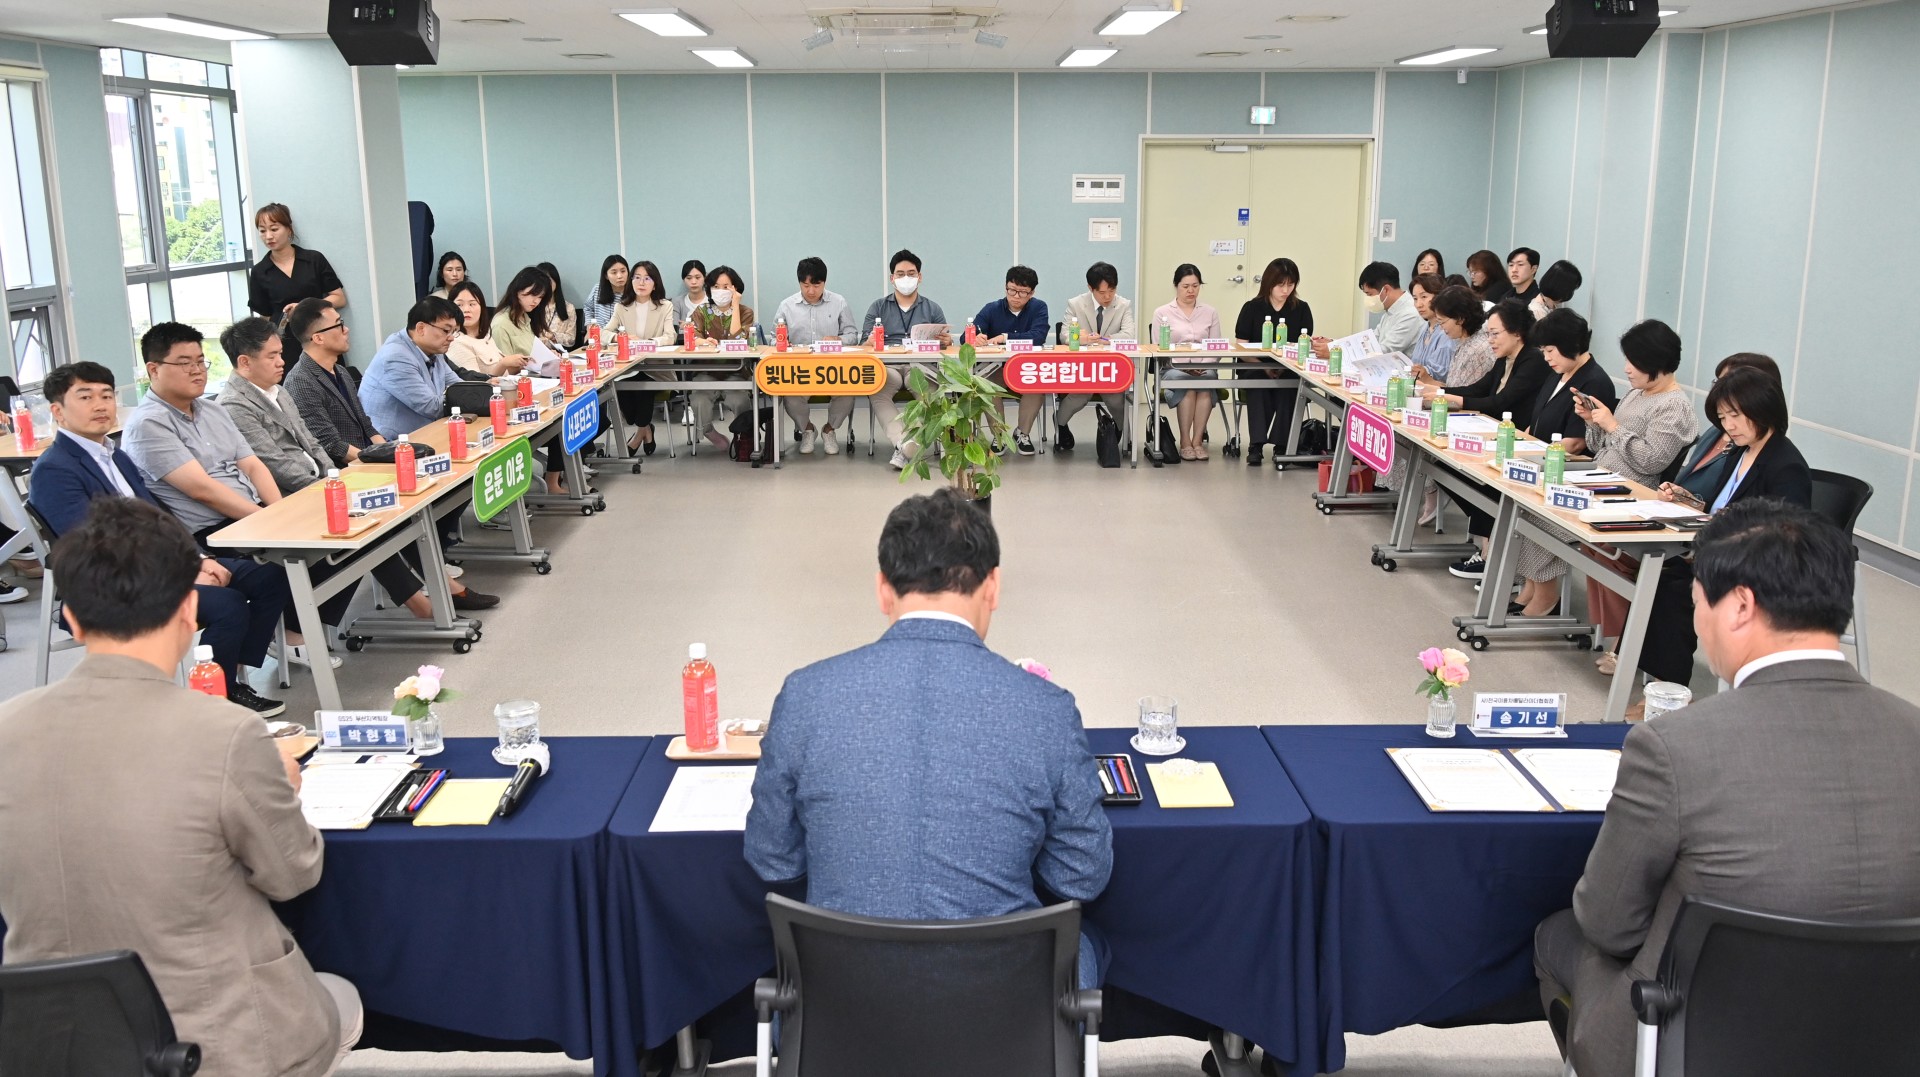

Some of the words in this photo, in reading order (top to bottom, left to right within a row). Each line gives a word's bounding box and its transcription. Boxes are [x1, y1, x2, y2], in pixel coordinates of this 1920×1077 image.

[765, 365, 811, 385] 빛나는
[815, 365, 876, 385] SOLO를
[1019, 362, 1119, 384] 응원합니다
[567, 399, 597, 443] 서포터즈가
[484, 464, 504, 505] 은둔
[505, 451, 525, 488] 이웃
[1556, 495, 1585, 509] 김윤정
[1500, 711, 1548, 725] 송기선
[347, 728, 397, 743] 박현철
